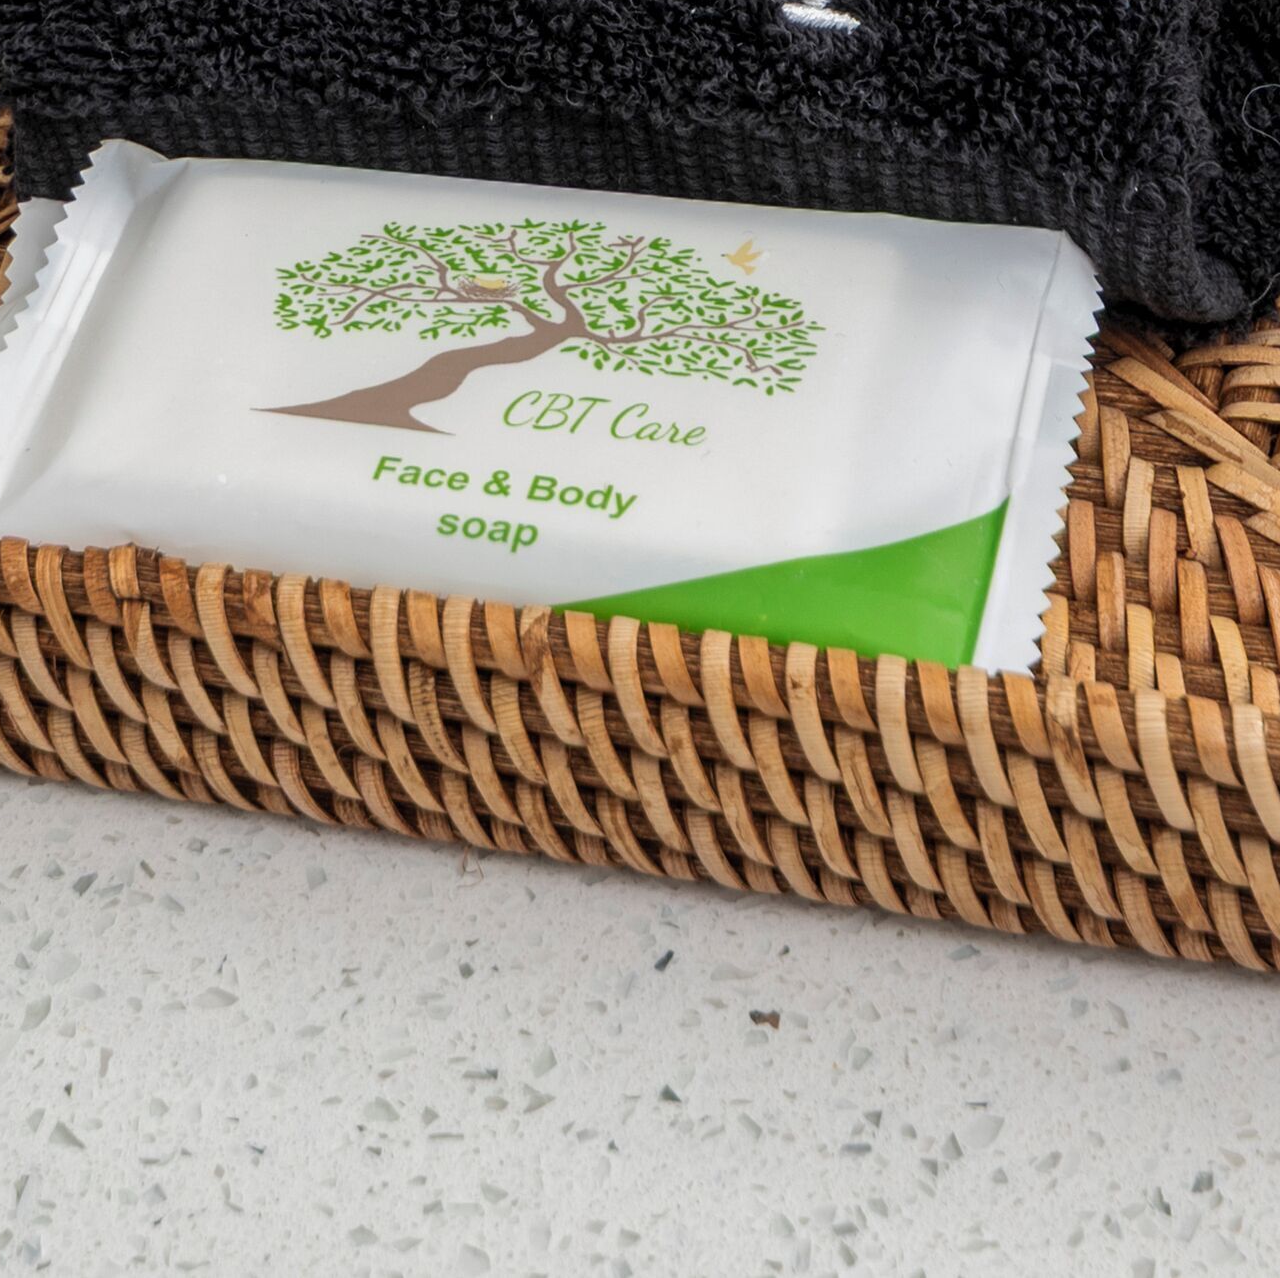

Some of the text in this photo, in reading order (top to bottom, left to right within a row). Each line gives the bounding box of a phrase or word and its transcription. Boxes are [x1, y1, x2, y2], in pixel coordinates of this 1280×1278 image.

[502, 390, 707, 447] CBT Care
[371, 455, 639, 519] Face & Body
[436, 513, 540, 553] soap
